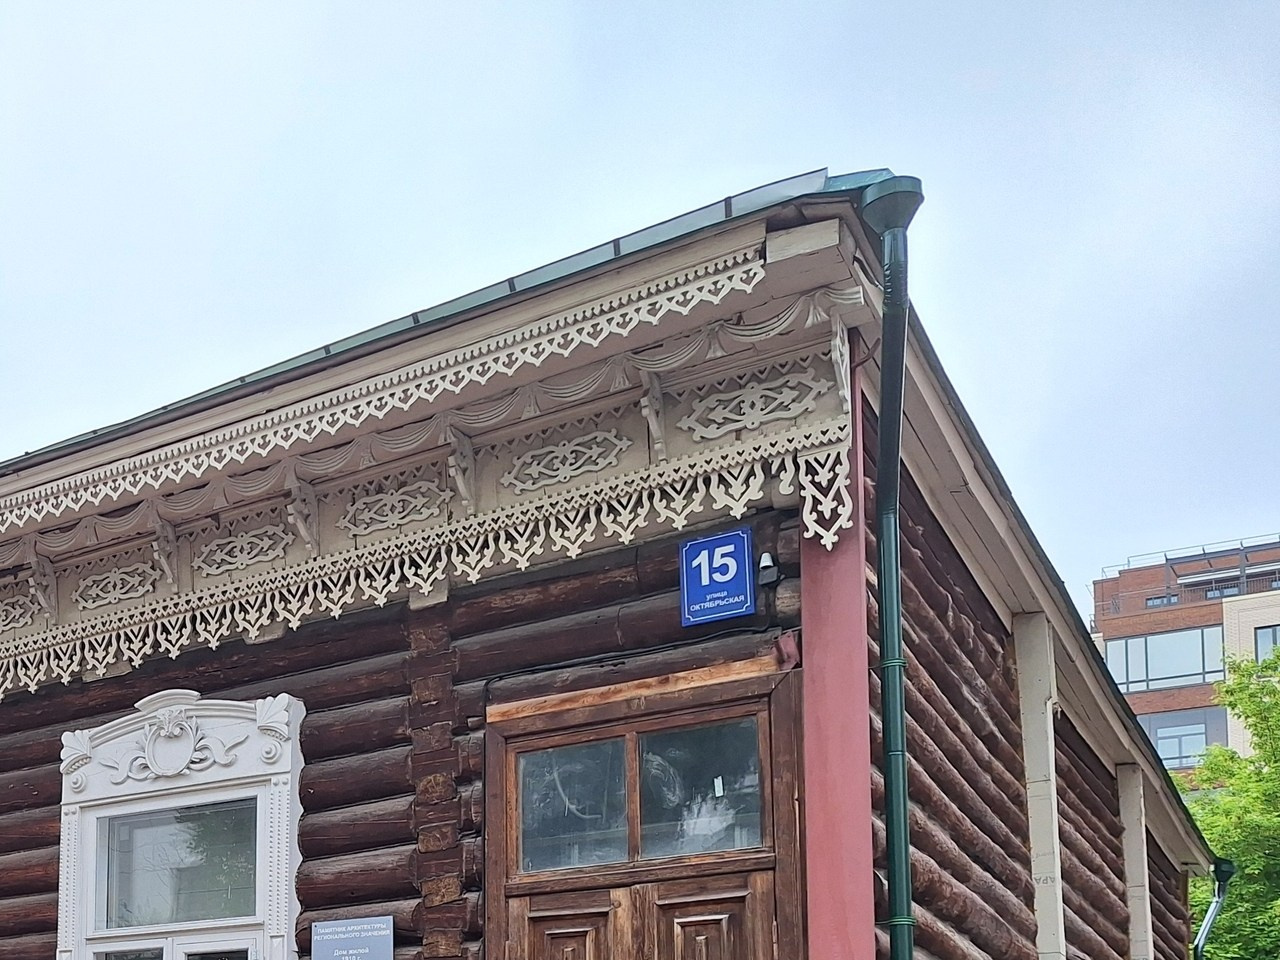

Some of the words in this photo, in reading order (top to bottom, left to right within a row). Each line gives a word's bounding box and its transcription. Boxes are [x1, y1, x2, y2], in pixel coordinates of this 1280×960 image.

[692, 544, 737, 586] 15
[706, 590, 727, 600] улица
[690, 595, 744, 611] ОКТЯБРЬСКАЯ
[347, 923, 387, 931] АРХИТЕКТУРЫ
[314, 932, 360, 940] РЕГИОНАЛЬНОГО
